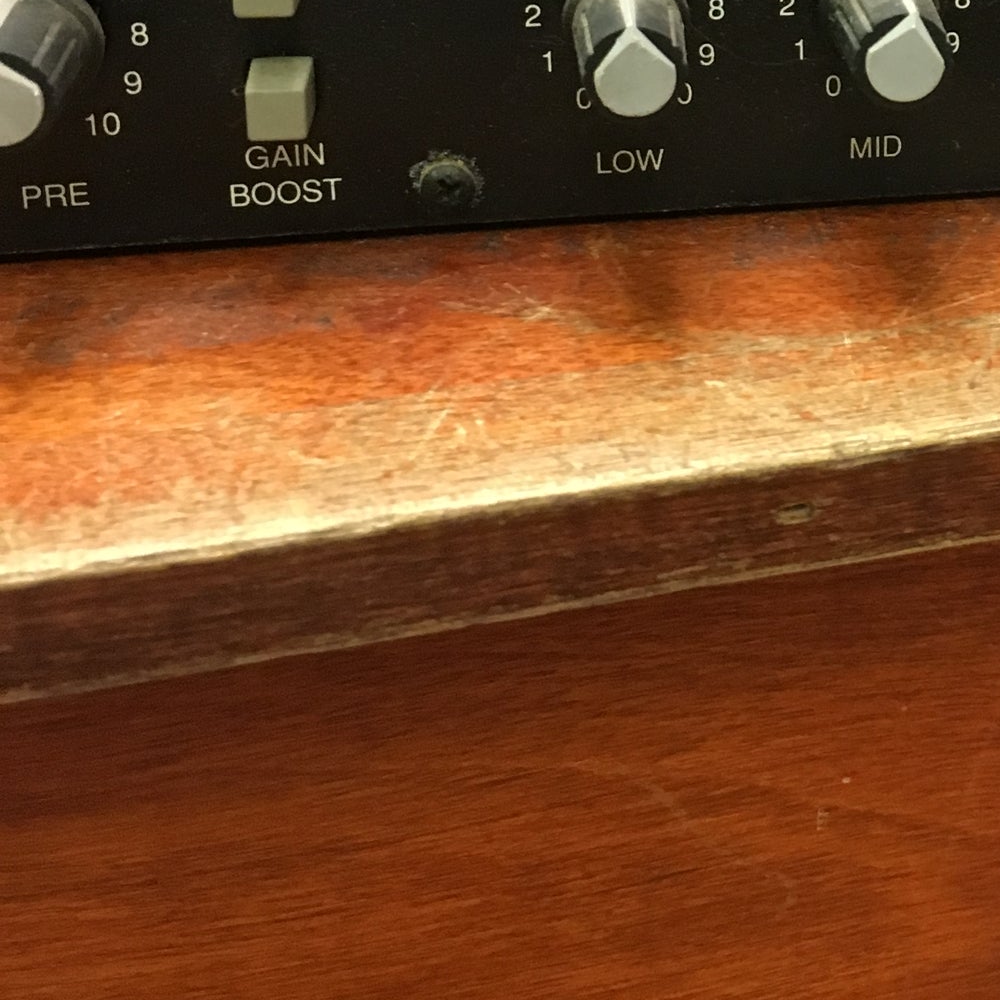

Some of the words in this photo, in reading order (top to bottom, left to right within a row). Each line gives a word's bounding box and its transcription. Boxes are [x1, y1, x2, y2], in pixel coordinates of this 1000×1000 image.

[524, 4, 542, 28] 2
[130, 22, 149, 47] 8
[945, 31, 960, 54] 9
[542, 50, 552, 73] 1
[698, 43, 715, 66] 9
[794, 38, 804, 61] 1
[123, 70, 142, 95] 9
[825, 75, 842, 97] 0
[85, 112, 121, 136] 10
[244, 142, 325, 170] GAIN
[850, 135, 902, 159] MID
[596, 148, 665, 174] LOW
[21, 181, 91, 210] PRE
[229, 177, 343, 207] BOOST
